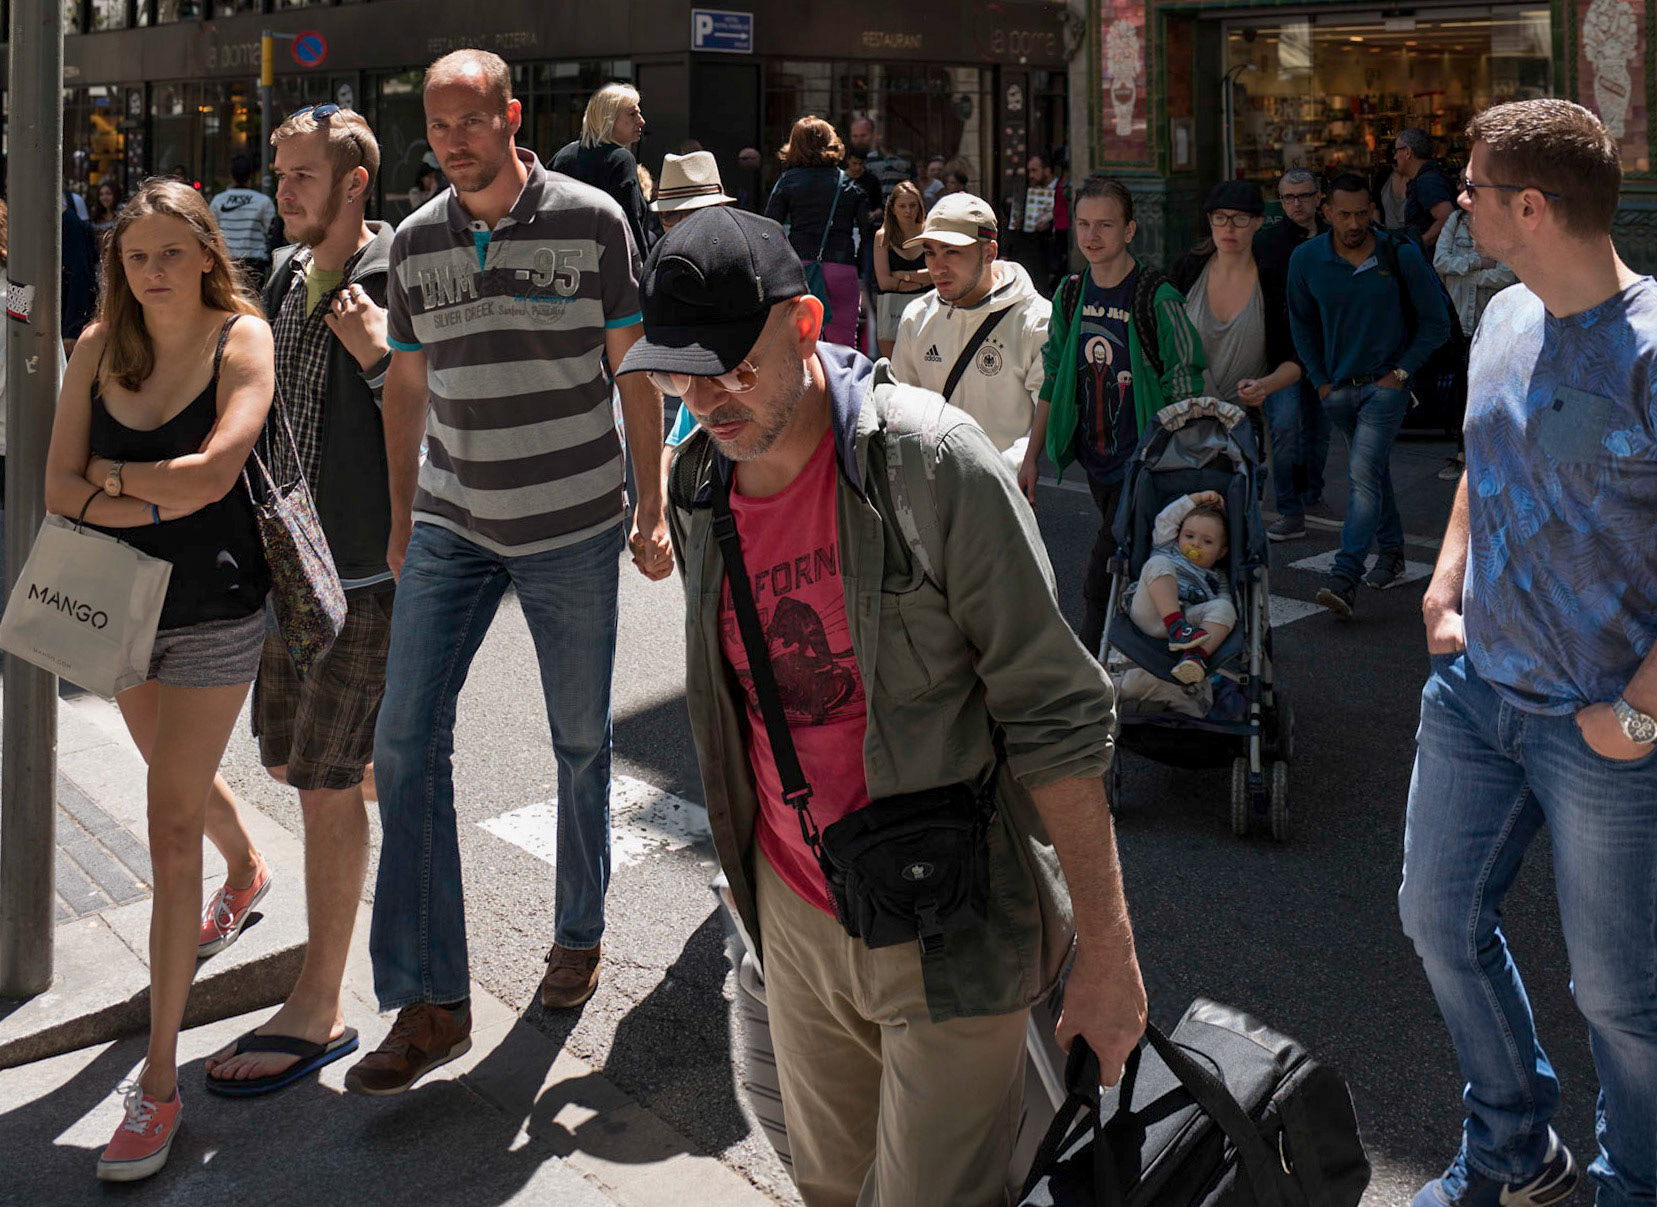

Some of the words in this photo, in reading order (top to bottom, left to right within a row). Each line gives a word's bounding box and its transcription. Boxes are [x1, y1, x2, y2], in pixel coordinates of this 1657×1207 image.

[696, 14, 713, 46] P
[515, 247, 582, 297] -95
[434, 308, 462, 330] SILVER
[465, 302, 494, 323] CREEK
[924, 354, 942, 363] adidas
[754, 543, 837, 603] FORN
[28, 583, 109, 630] MANGO
